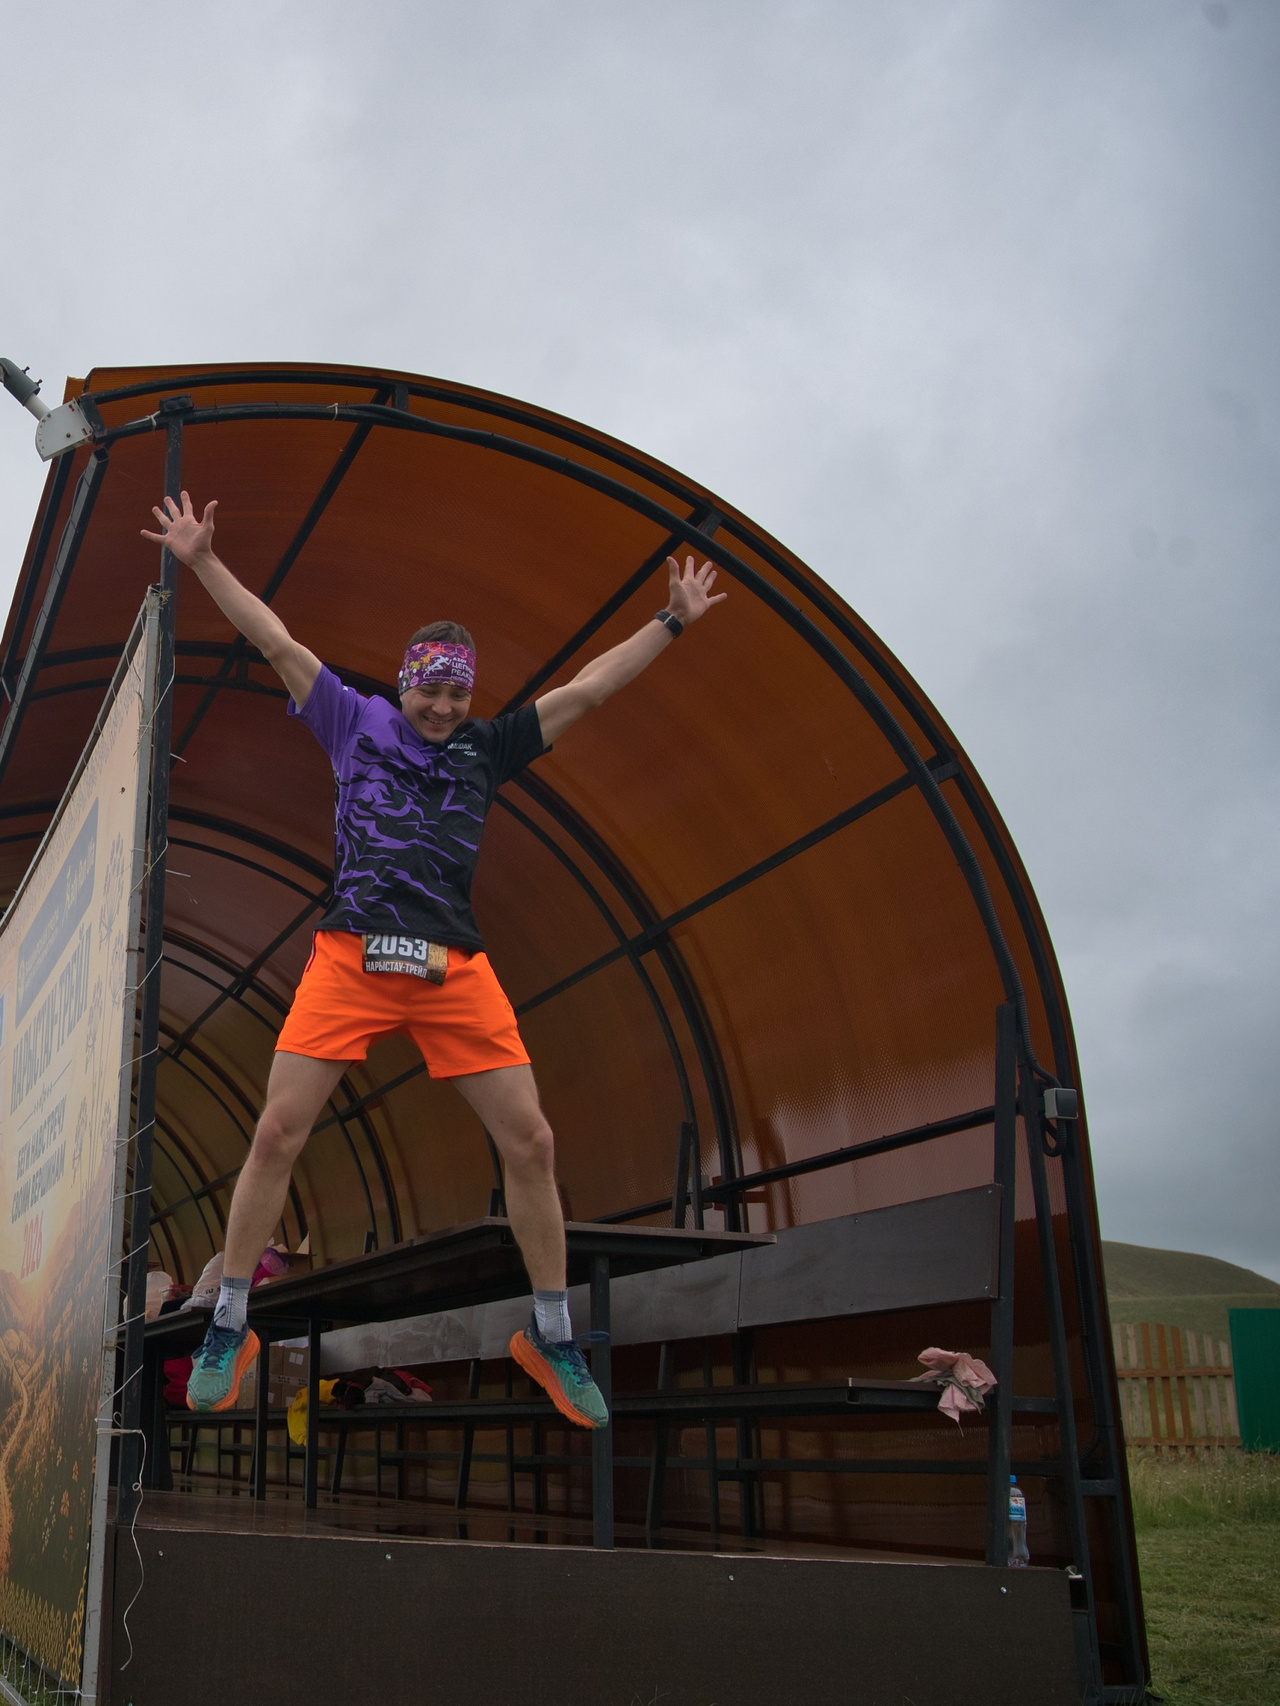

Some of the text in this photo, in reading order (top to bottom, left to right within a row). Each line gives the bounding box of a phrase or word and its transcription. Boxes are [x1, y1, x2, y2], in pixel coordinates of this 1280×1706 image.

[366, 933, 428, 961] 2053
[365, 961, 428, 979] НАРЫСТАУ-ТРЕЙЛ
[10, 921, 92, 1116] НАРЫСТАУ-ТРЕЙЛ
